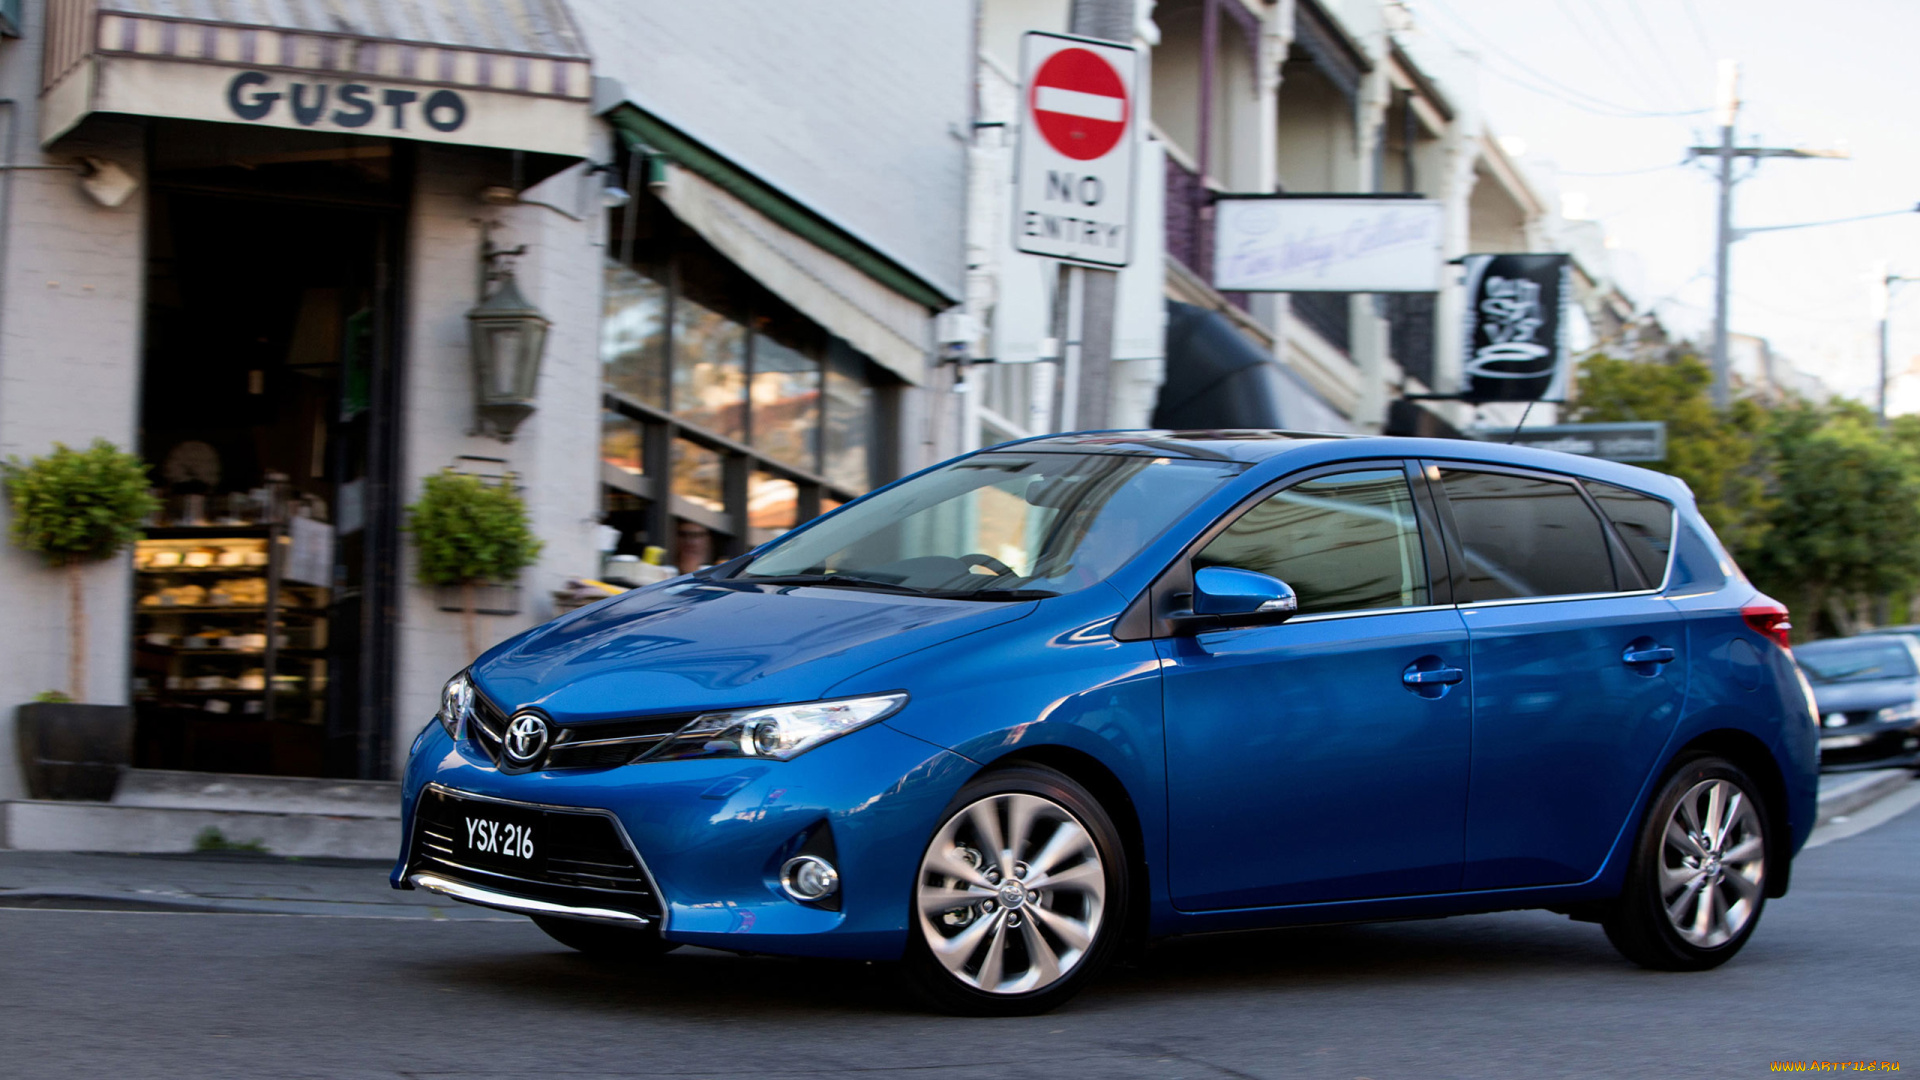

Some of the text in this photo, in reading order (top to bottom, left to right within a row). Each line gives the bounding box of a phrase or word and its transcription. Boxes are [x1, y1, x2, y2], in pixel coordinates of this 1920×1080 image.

[227, 71, 467, 132] GUSTO
[1046, 169, 1104, 207] NO
[1024, 211, 1124, 248] ENTRY
